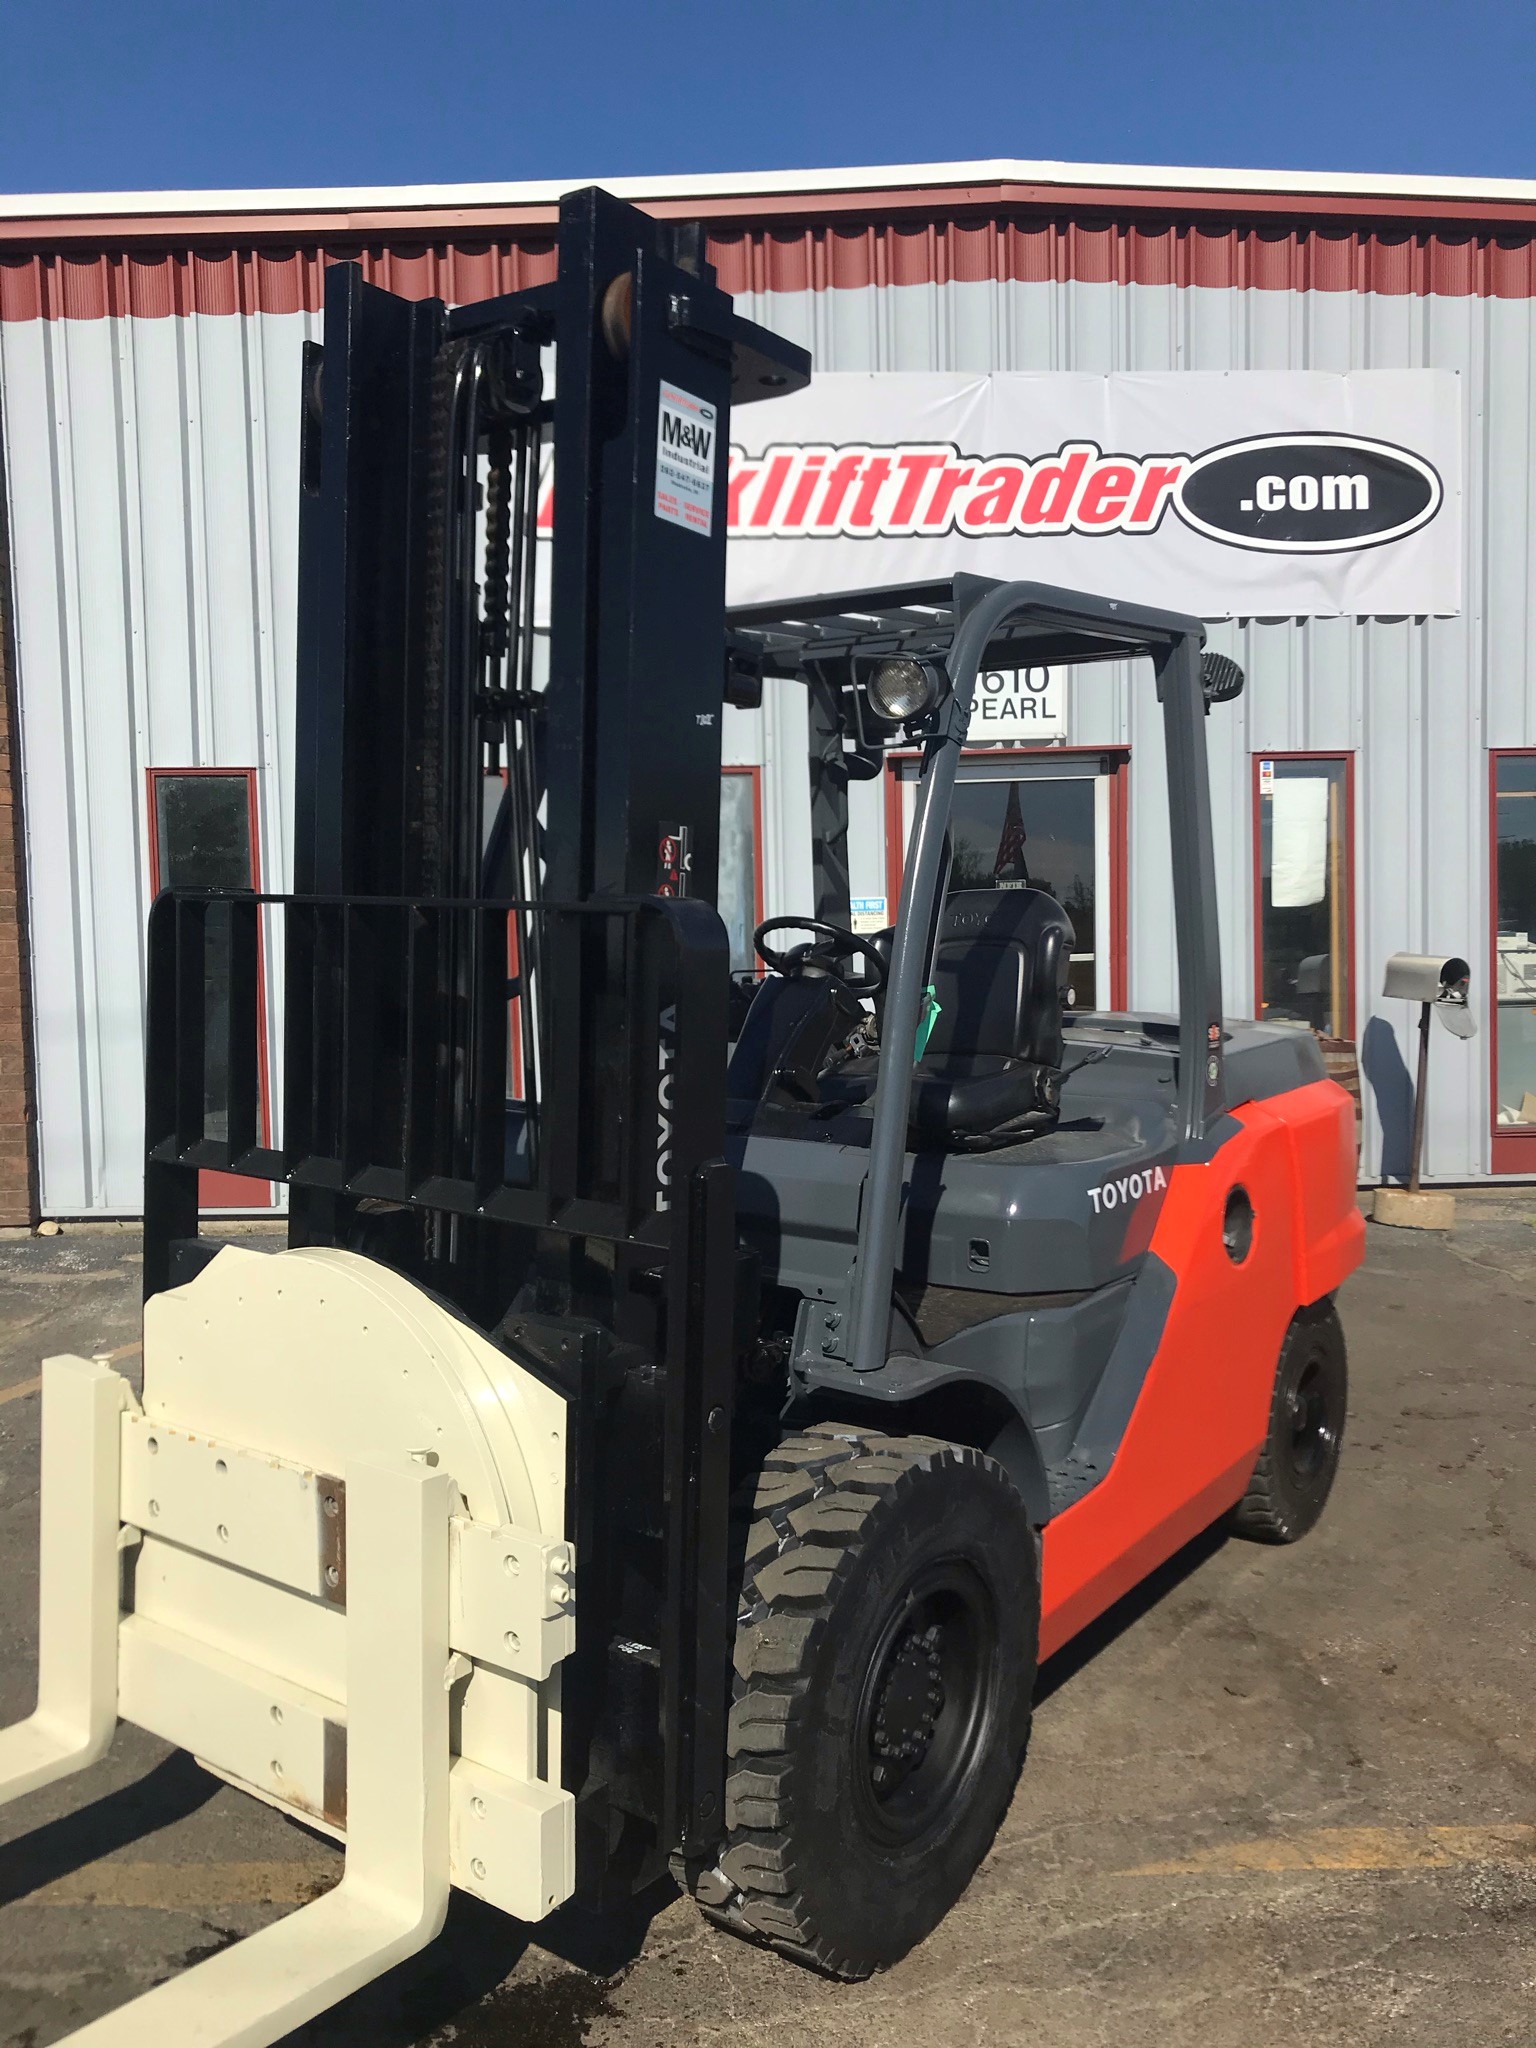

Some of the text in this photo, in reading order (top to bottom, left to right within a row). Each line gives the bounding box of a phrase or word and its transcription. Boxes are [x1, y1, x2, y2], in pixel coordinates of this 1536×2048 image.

[662, 410, 711, 460] M&W
[662, 446, 710, 474] Industrial
[728, 452, 1370, 526] kliftTrader .com
[969, 697, 1057, 720] PEARL
[1086, 1165, 1168, 1214] TOYOTA
